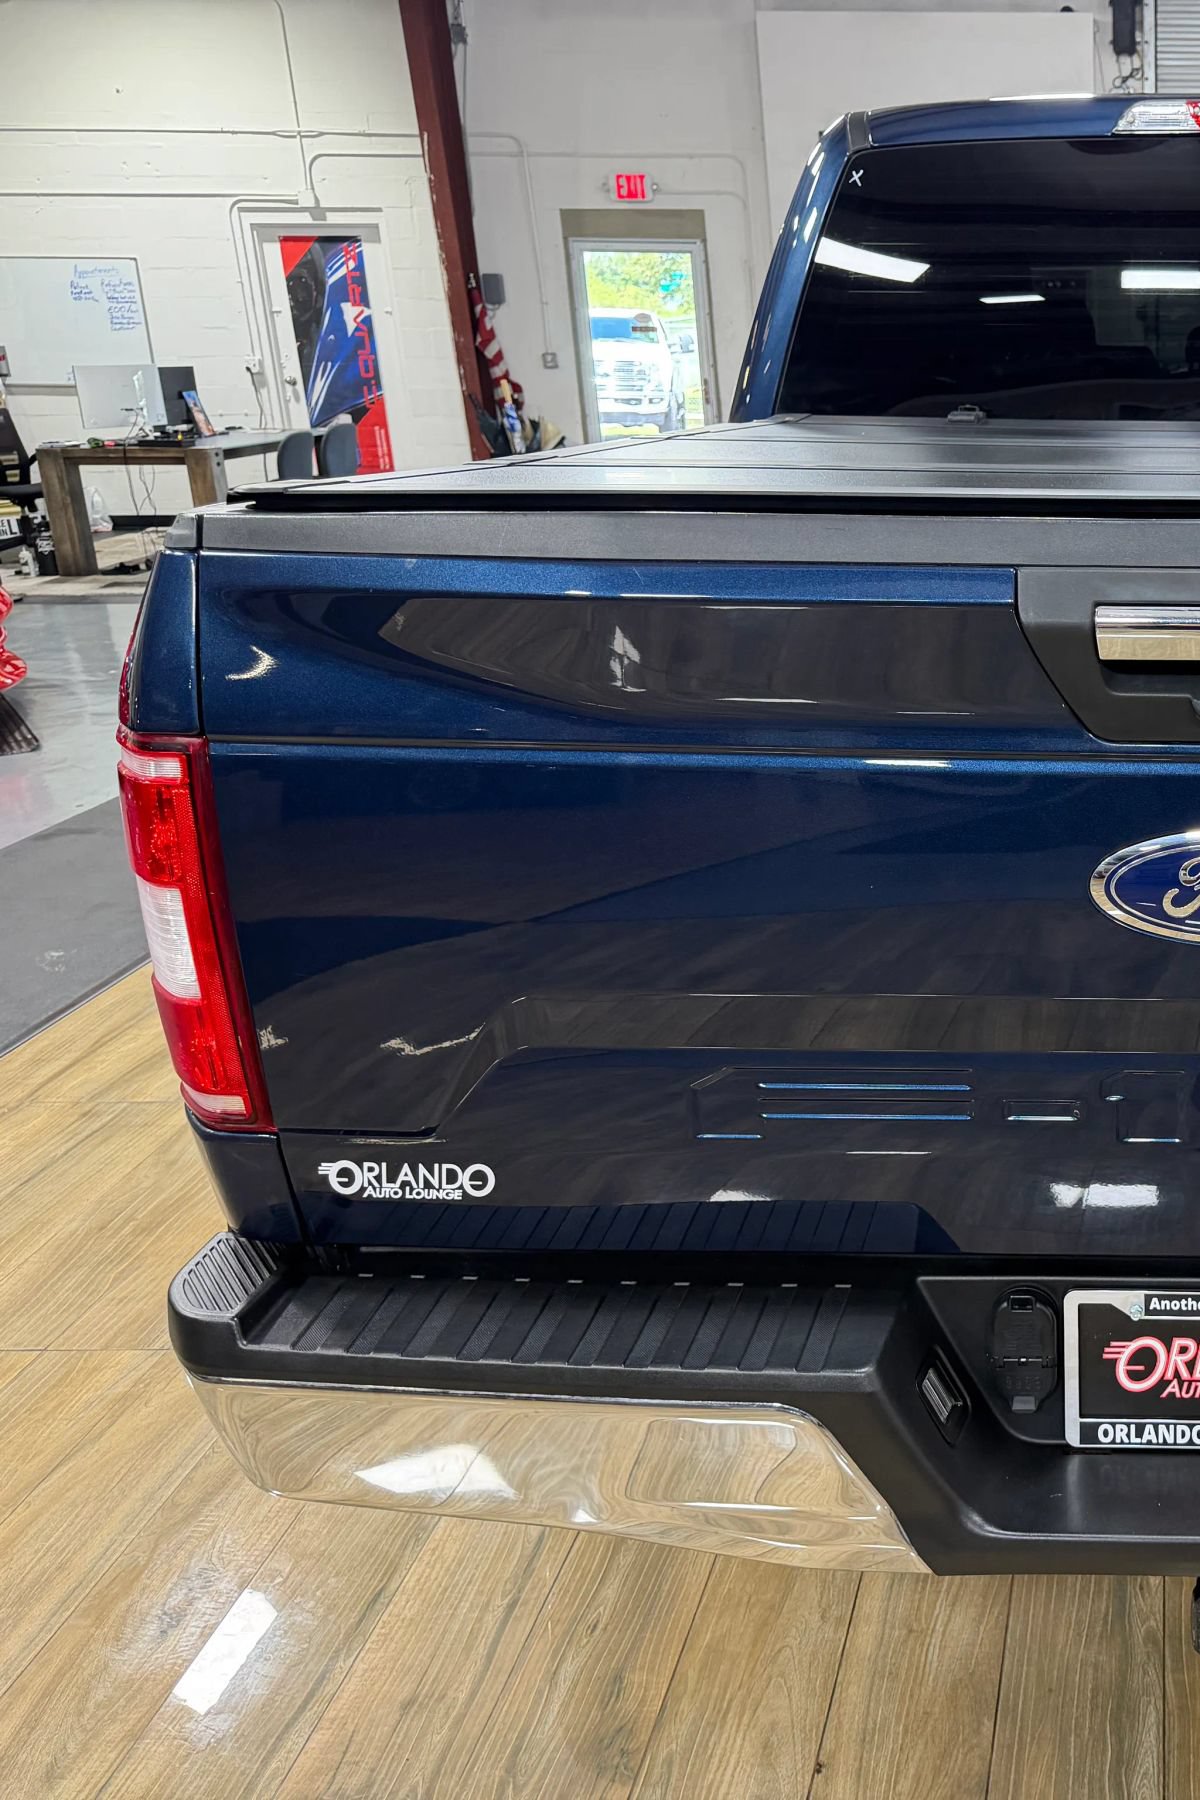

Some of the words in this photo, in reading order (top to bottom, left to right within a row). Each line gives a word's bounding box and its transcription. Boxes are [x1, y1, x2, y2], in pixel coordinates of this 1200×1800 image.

[615, 174, 646, 200] EXIT
[320, 1159, 496, 1197] ORLANDO
[362, 1185, 403, 1199] AUTO
[405, 1186, 463, 1200] LOUNGE
